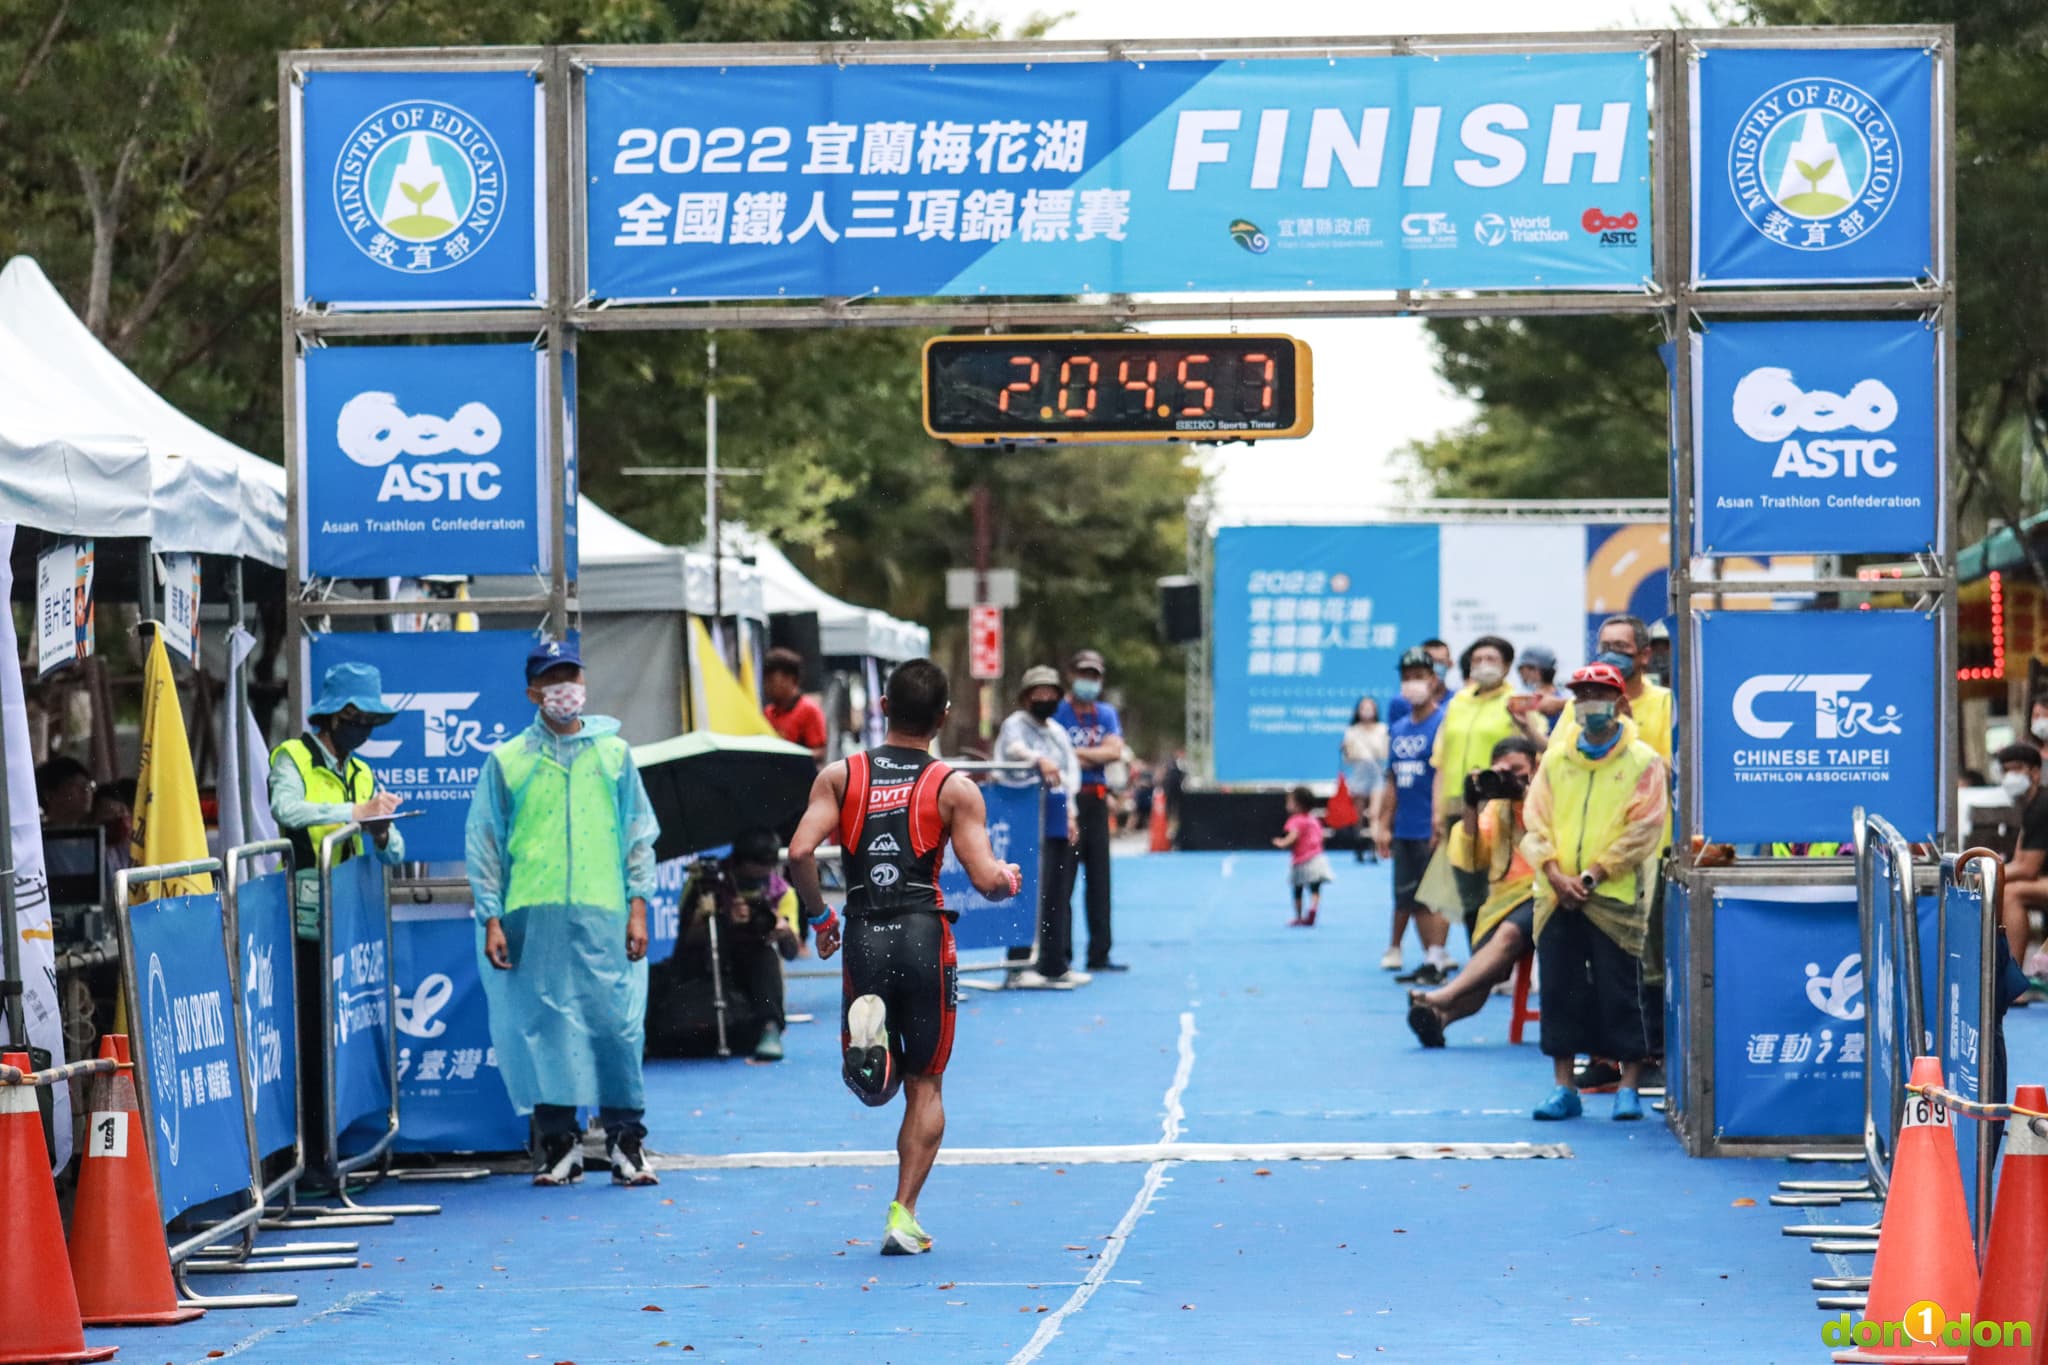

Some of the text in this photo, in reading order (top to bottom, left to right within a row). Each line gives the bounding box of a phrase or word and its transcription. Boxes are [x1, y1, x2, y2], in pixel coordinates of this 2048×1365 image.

[614, 119, 1088, 175] 2022 宜蘭梅花湖
[1167, 101, 1631, 191] FINISH
[1736, 85, 1895, 213] MINISTRY OF EDUCATION
[340, 108, 499, 237] MINISTRY OF EDUCATION
[614, 188, 1132, 246] 全國鐵人三項錦標賽
[1509, 216, 1551, 228] World
[1509, 229, 1569, 242] Triathlon
[1600, 231, 1637, 244] ASTC
[1762, 209, 1867, 248] 教育部
[368, 231, 472, 270] 教育部
[1176, 420, 1276, 430] SEIKO Sports Timer
[1771, 439, 1898, 478] ASTC
[377, 461, 502, 502] ASTC
[1716, 495, 1921, 508] Asian Triathlon Confederation
[321, 518, 525, 533] Asian Triathlon Confederation
[1733, 749, 1890, 765] CHINESE TAIPEI
[376, 768, 429, 784] NESE
[1734, 771, 1889, 782] TRIATHLON ASSOCIATION
[416, 790, 478, 800] ASSOCIAT
[870, 786, 913, 803] DVTT
[190, 990, 225, 1051] SPORTS
[1903, 1099, 1946, 1126] 169
